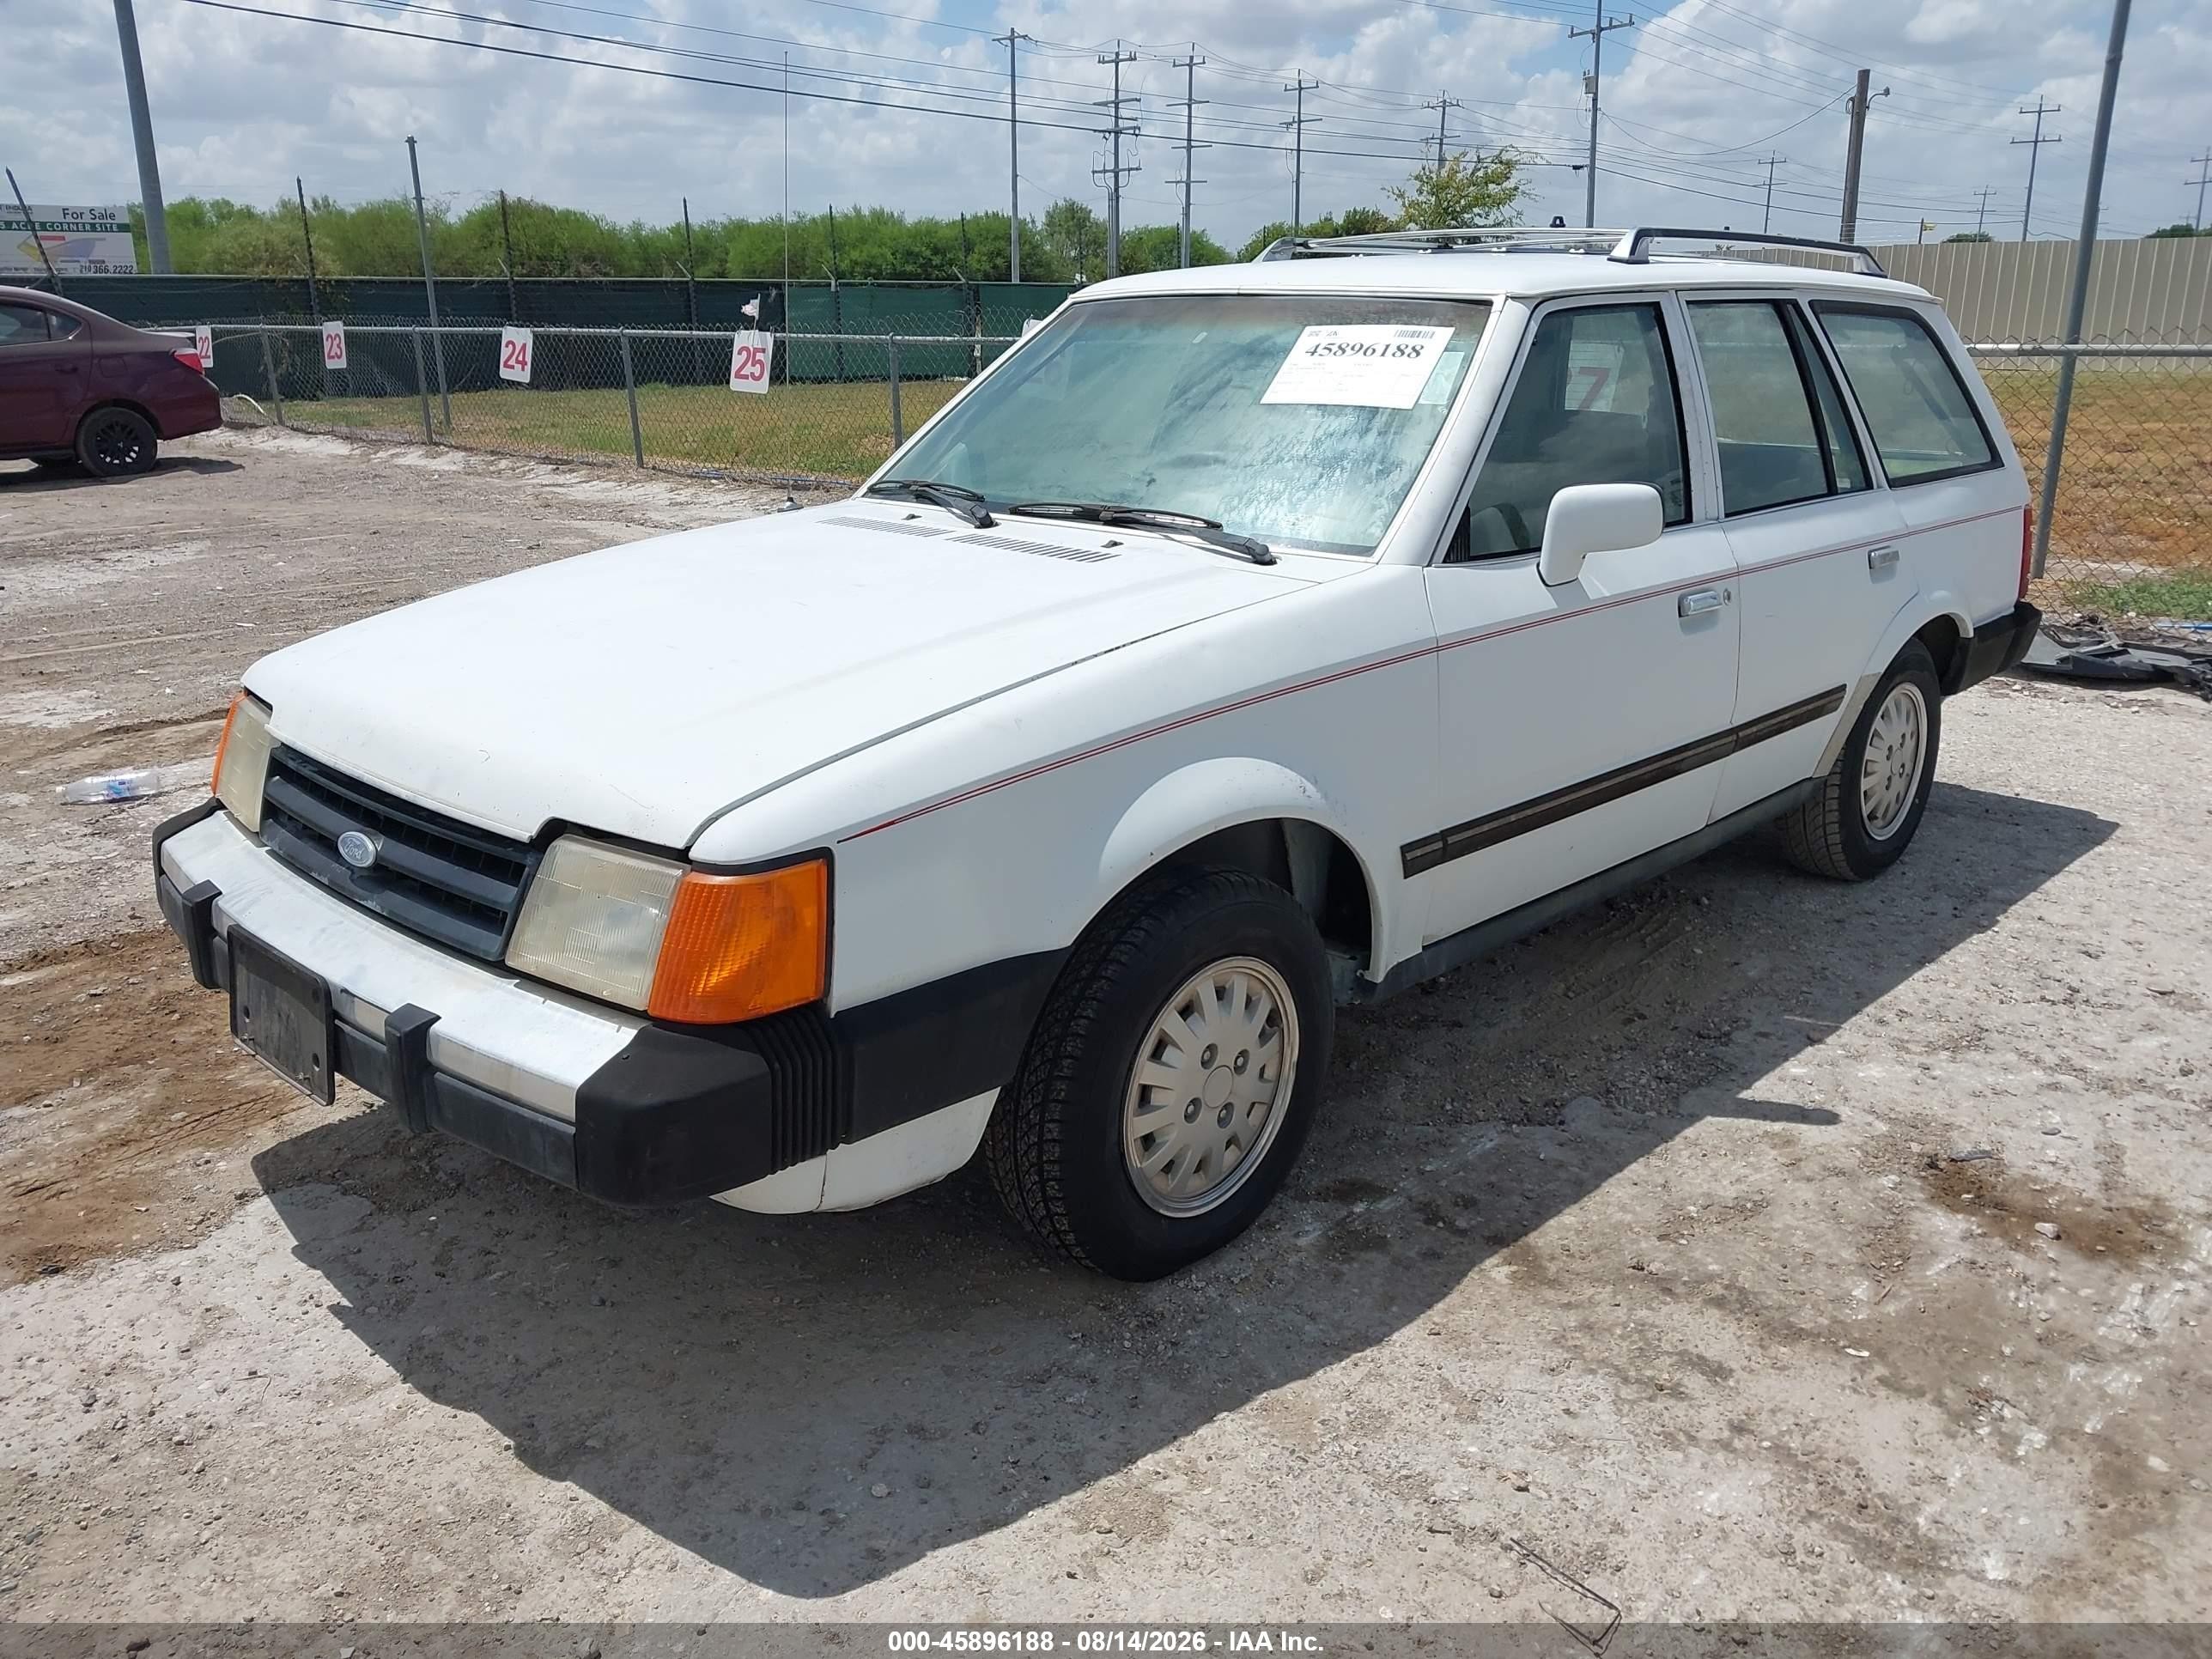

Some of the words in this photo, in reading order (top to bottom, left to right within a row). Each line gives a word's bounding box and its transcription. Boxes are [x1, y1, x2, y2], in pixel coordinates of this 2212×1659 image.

[61, 208, 85, 220] For
[88, 208, 116, 221] Sale
[46, 222, 91, 232] CORNER
[95, 223, 118, 232] SITE
[198, 336, 211, 359] 22
[325, 333, 343, 360] 23
[502, 339, 528, 372] 24
[1304, 342, 1425, 359] 45896188
[733, 345, 766, 381] 25
